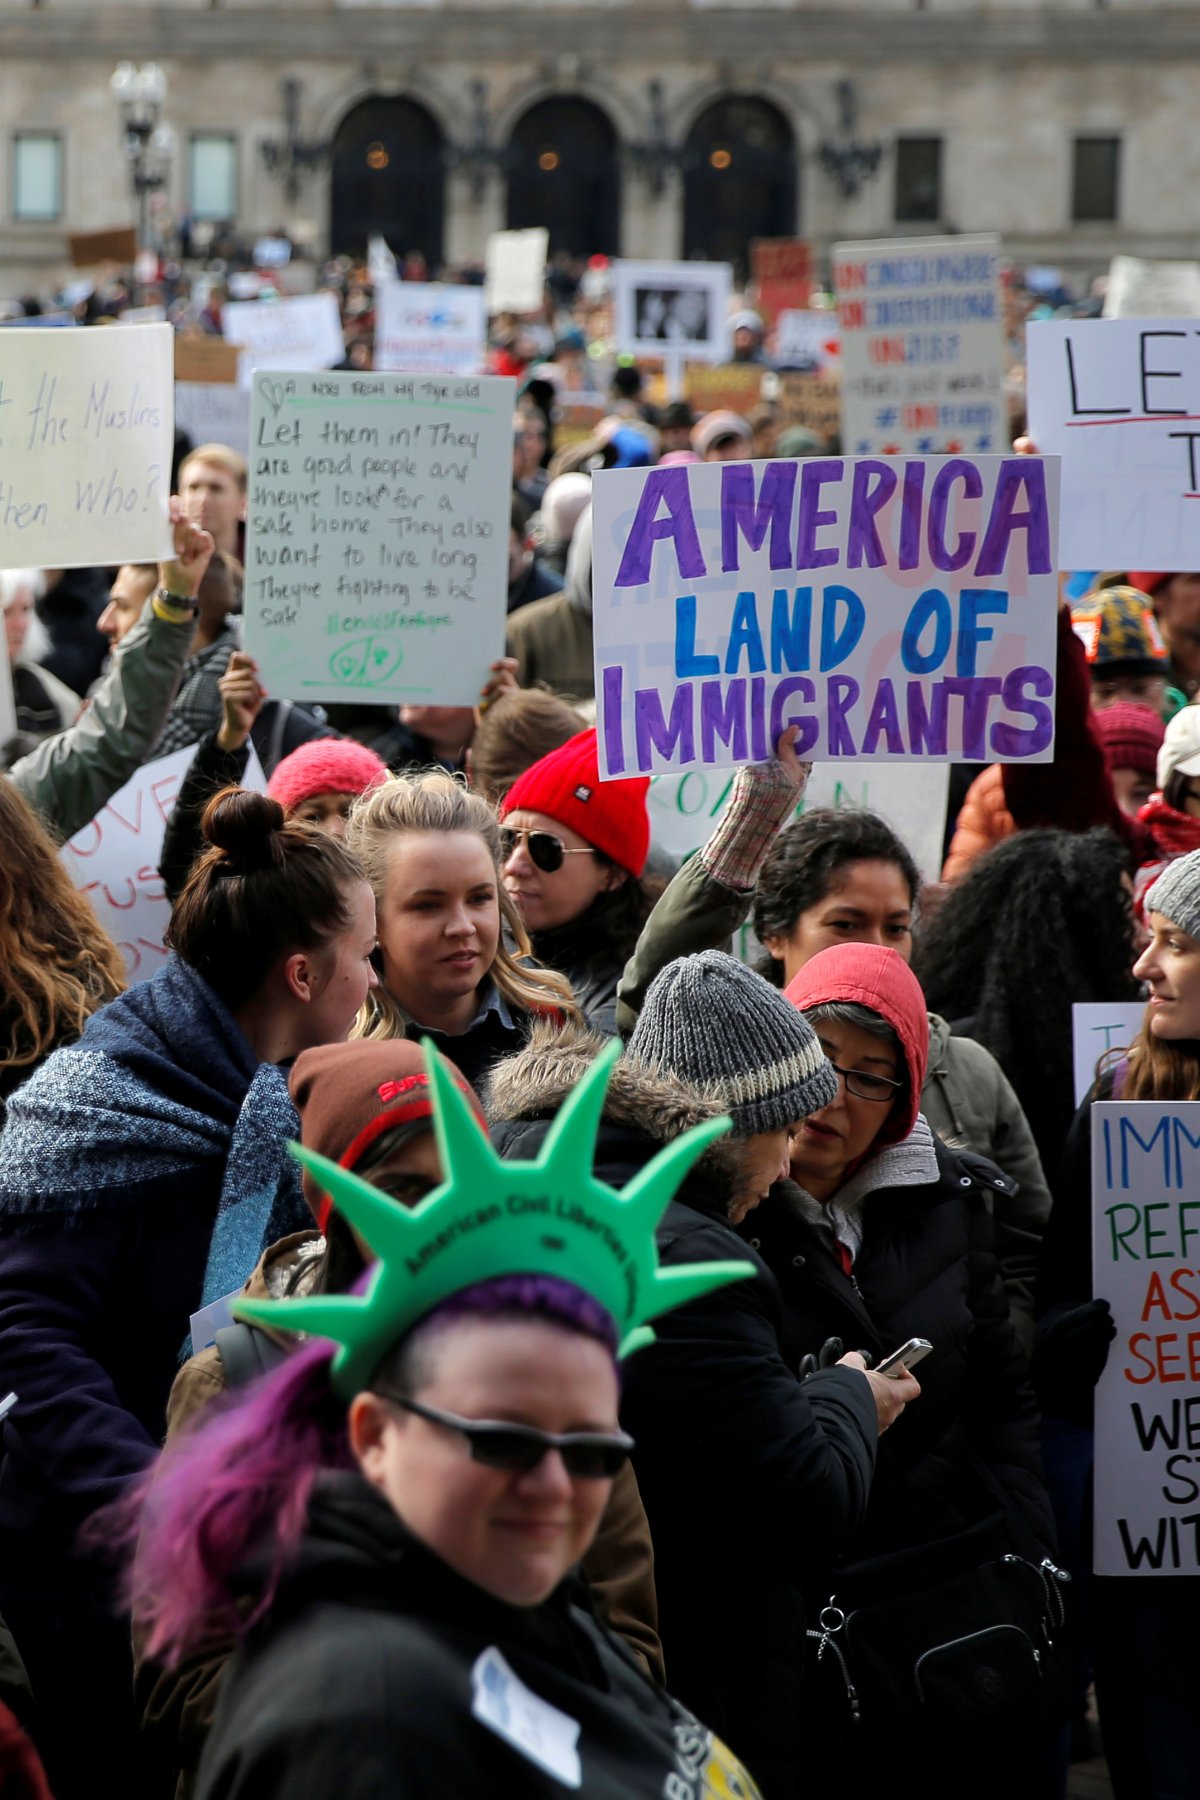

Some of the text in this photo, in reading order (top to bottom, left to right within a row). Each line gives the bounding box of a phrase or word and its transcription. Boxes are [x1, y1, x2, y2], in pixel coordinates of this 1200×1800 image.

[1065, 329, 1200, 416] LE
[27, 372, 69, 450] the
[256, 416, 303, 448] Let
[320, 421, 379, 448] them
[426, 422, 480, 459] They
[75, 464, 161, 516] Who?
[256, 457, 291, 477] are
[303, 454, 354, 484] good
[362, 457, 418, 481] people
[252, 511, 494, 545] safe home They also
[438, 493, 454, 513] a
[614, 458, 1053, 588] AMERICA
[255, 543, 479, 581] want to live long
[448, 578, 478, 602] be
[675, 585, 1009, 678] LAND OF
[602, 665, 1055, 775] IMMIGRANTS
[405, 1203, 502, 1277] American
[506, 1194, 551, 1216] Civil
